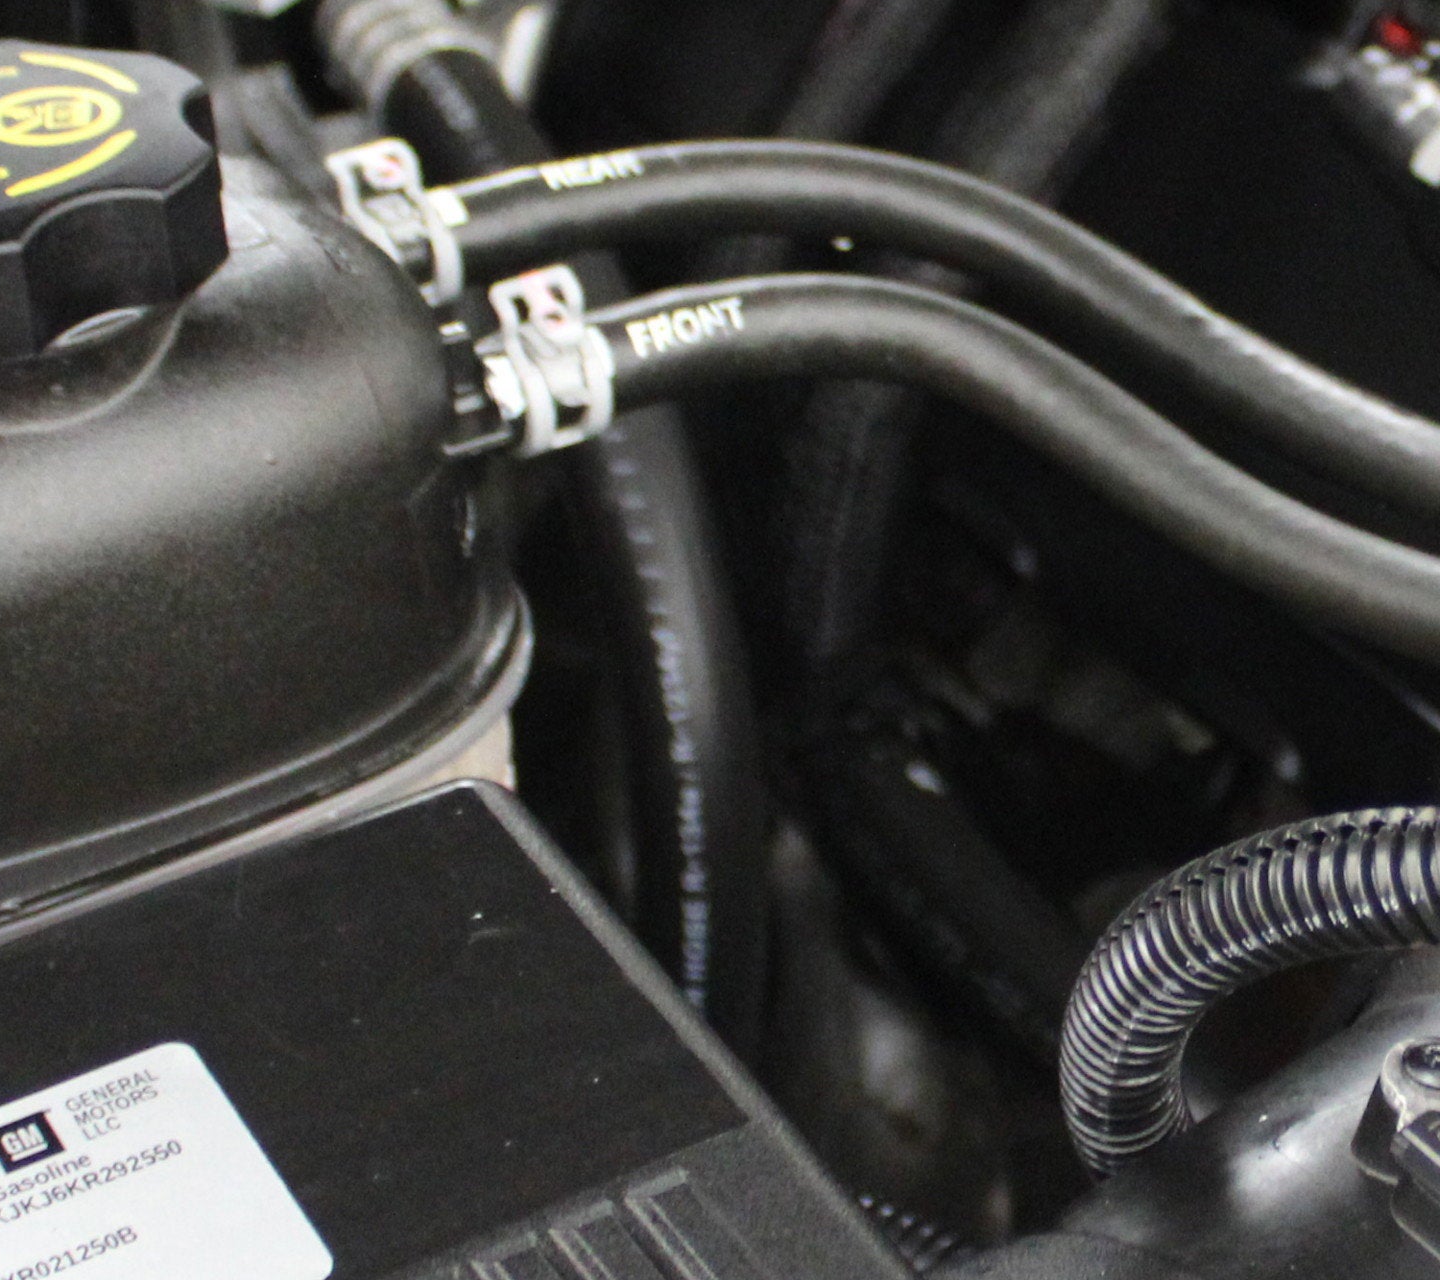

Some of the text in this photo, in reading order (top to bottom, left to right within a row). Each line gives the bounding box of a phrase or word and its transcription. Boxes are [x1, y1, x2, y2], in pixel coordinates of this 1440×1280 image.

[626, 297, 744, 357] FRONT
[64, 1069, 159, 1114] GENERAL
[73, 1085, 158, 1128] MOTORS
[1, 1123, 45, 1156] GM
[81, 1116, 121, 1142] LLC
